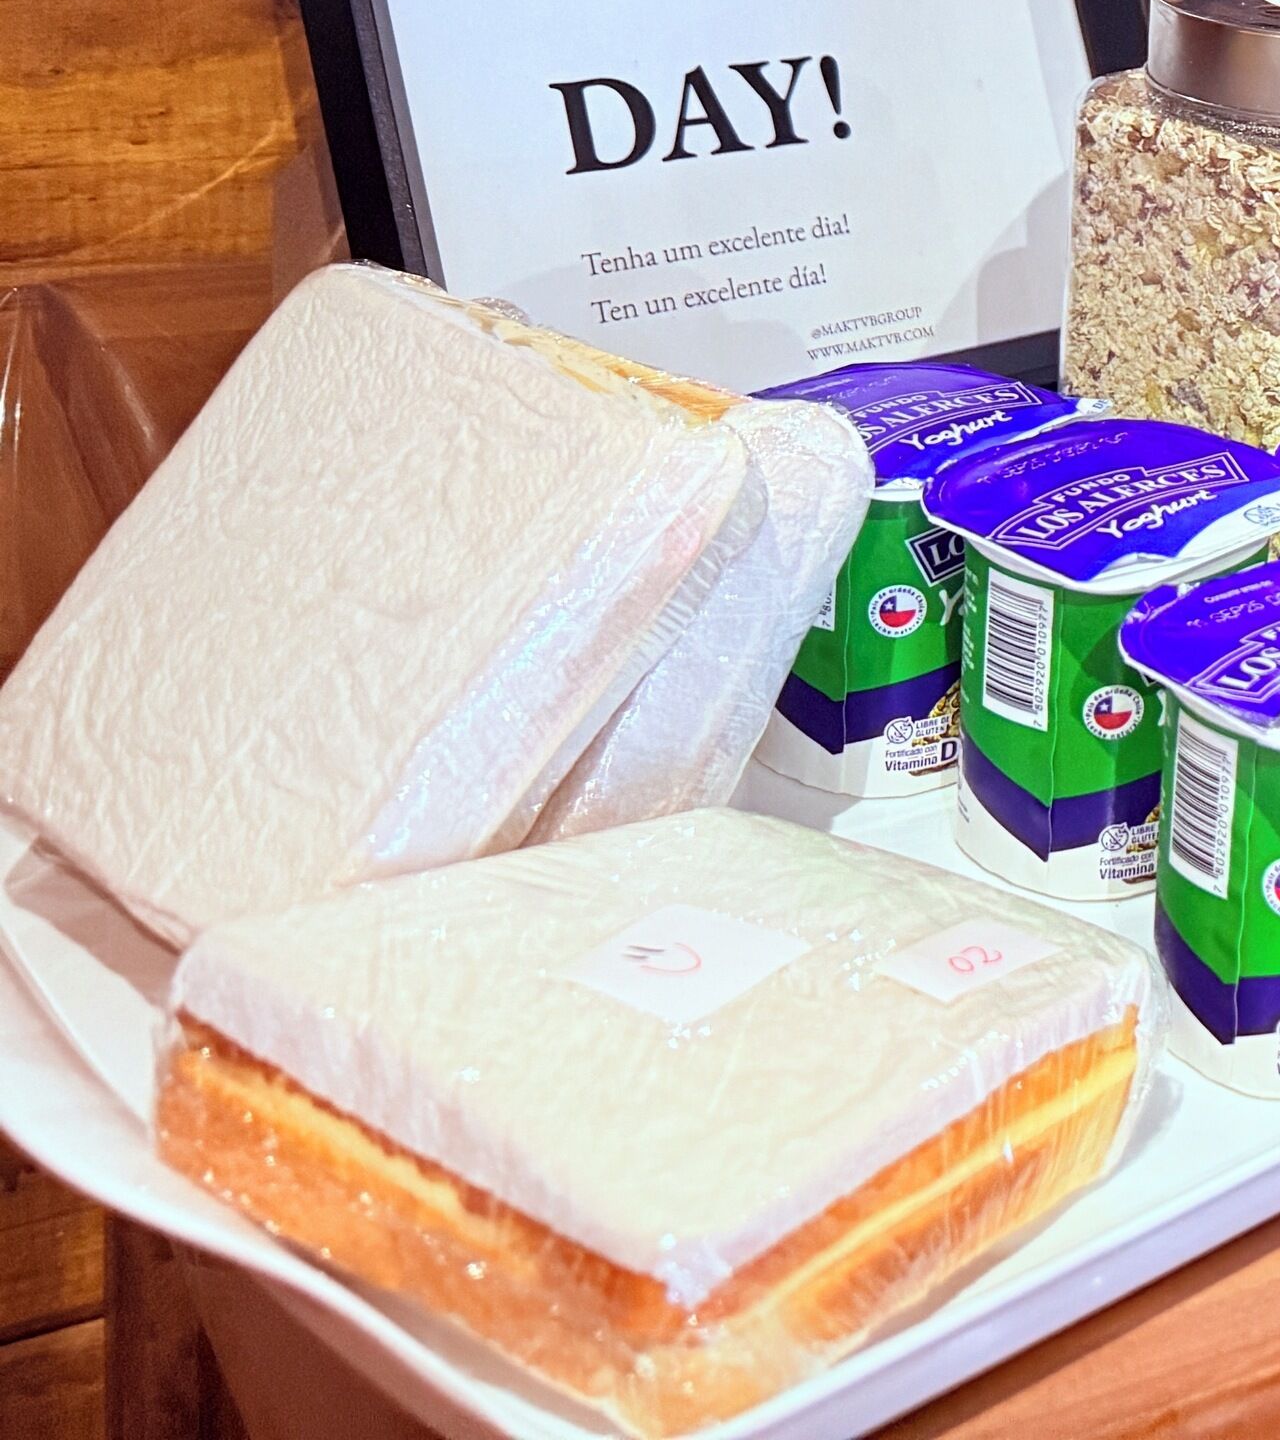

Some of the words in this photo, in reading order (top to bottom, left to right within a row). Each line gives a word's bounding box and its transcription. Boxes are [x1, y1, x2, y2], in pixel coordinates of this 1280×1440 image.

[548, 55, 852, 175] DAY!
[581, 246, 659, 276] Tenha
[664, 243, 703, 264] um
[708, 226, 807, 257] excelente
[811, 213, 852, 240] dia!
[591, 298, 639, 325] Ten
[645, 296, 677, 315] un
[684, 277, 784, 307] excelente
[788, 263, 828, 289] día!
[810, 306, 924, 340] @MAKTVBGROUP
[806, 326, 935, 361] WWW.MAKTVB.COM
[857, 393, 930, 422] FUNDO
[879, 388, 1021, 437] ALERCES
[899, 410, 1013, 452] Yoghurt
[1018, 505, 1085, 545] LOS
[1083, 463, 1228, 519] ALERCES
[1052, 472, 1133, 503] FUNDO
[1096, 490, 1218, 539] Yoghurt
[927, 534, 966, 568] LO
[1034, 662, 1047, 712] 802920
[915, 719, 939, 730] LIBRE
[915, 726, 946, 738] GLUTEN
[885, 755, 938, 772] Vitamina
[940, 740, 958, 762] D
[1131, 824, 1155, 836] LIBRE
[1213, 819, 1228, 878] 802920
[1099, 863, 1155, 880] Vitamina
